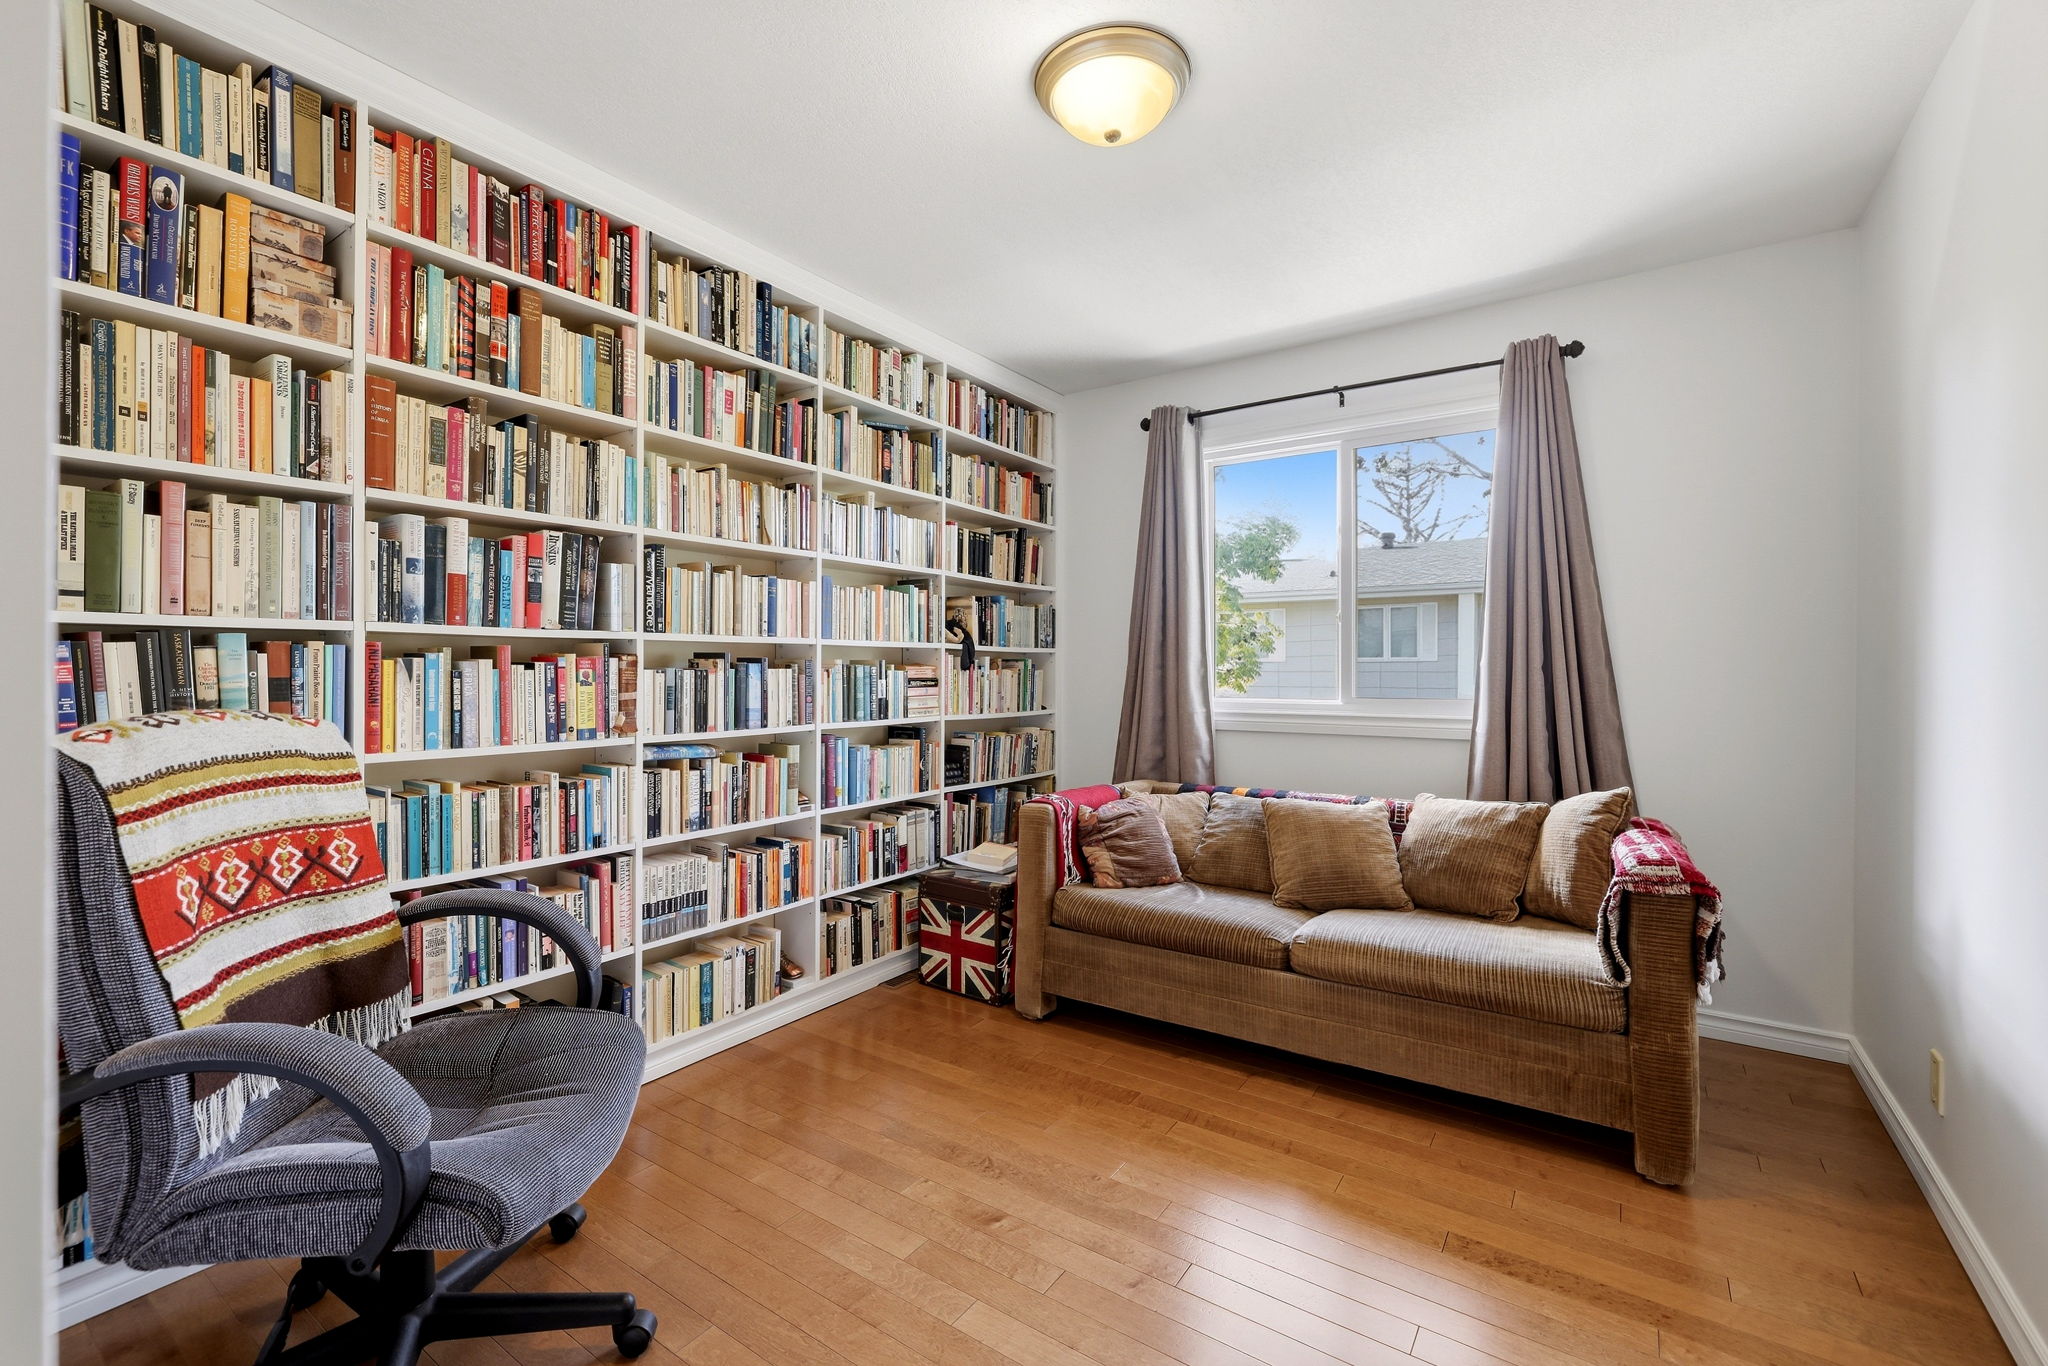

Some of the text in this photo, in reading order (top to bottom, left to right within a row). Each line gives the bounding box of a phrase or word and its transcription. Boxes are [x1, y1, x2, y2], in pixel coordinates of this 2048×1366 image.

[97, 29, 111, 111] The Delight Makers
[81, 173, 92, 187] The
[422, 148, 434, 190] CHINA
[80, 187, 91, 200] Age
[126, 163, 141, 221] OBAMA'S WARS
[377, 181, 387, 211] SAIGON
[96, 233, 104, 251] HOPE
[228, 217, 237, 272] ROOSEVELT
[238, 225, 248, 269] ELEANOR
[237, 381, 245, 389] The
[488, 566, 496, 577] THE
[565, 549, 573, 575] AUGUST
[488, 578, 496, 596] GREAT
[502, 575, 511, 610] STALIN
[488, 596, 496, 620] TERROR
[173, 633, 185, 685] SASKATCHEWAN
[464, 668, 474, 697] AFRICA
